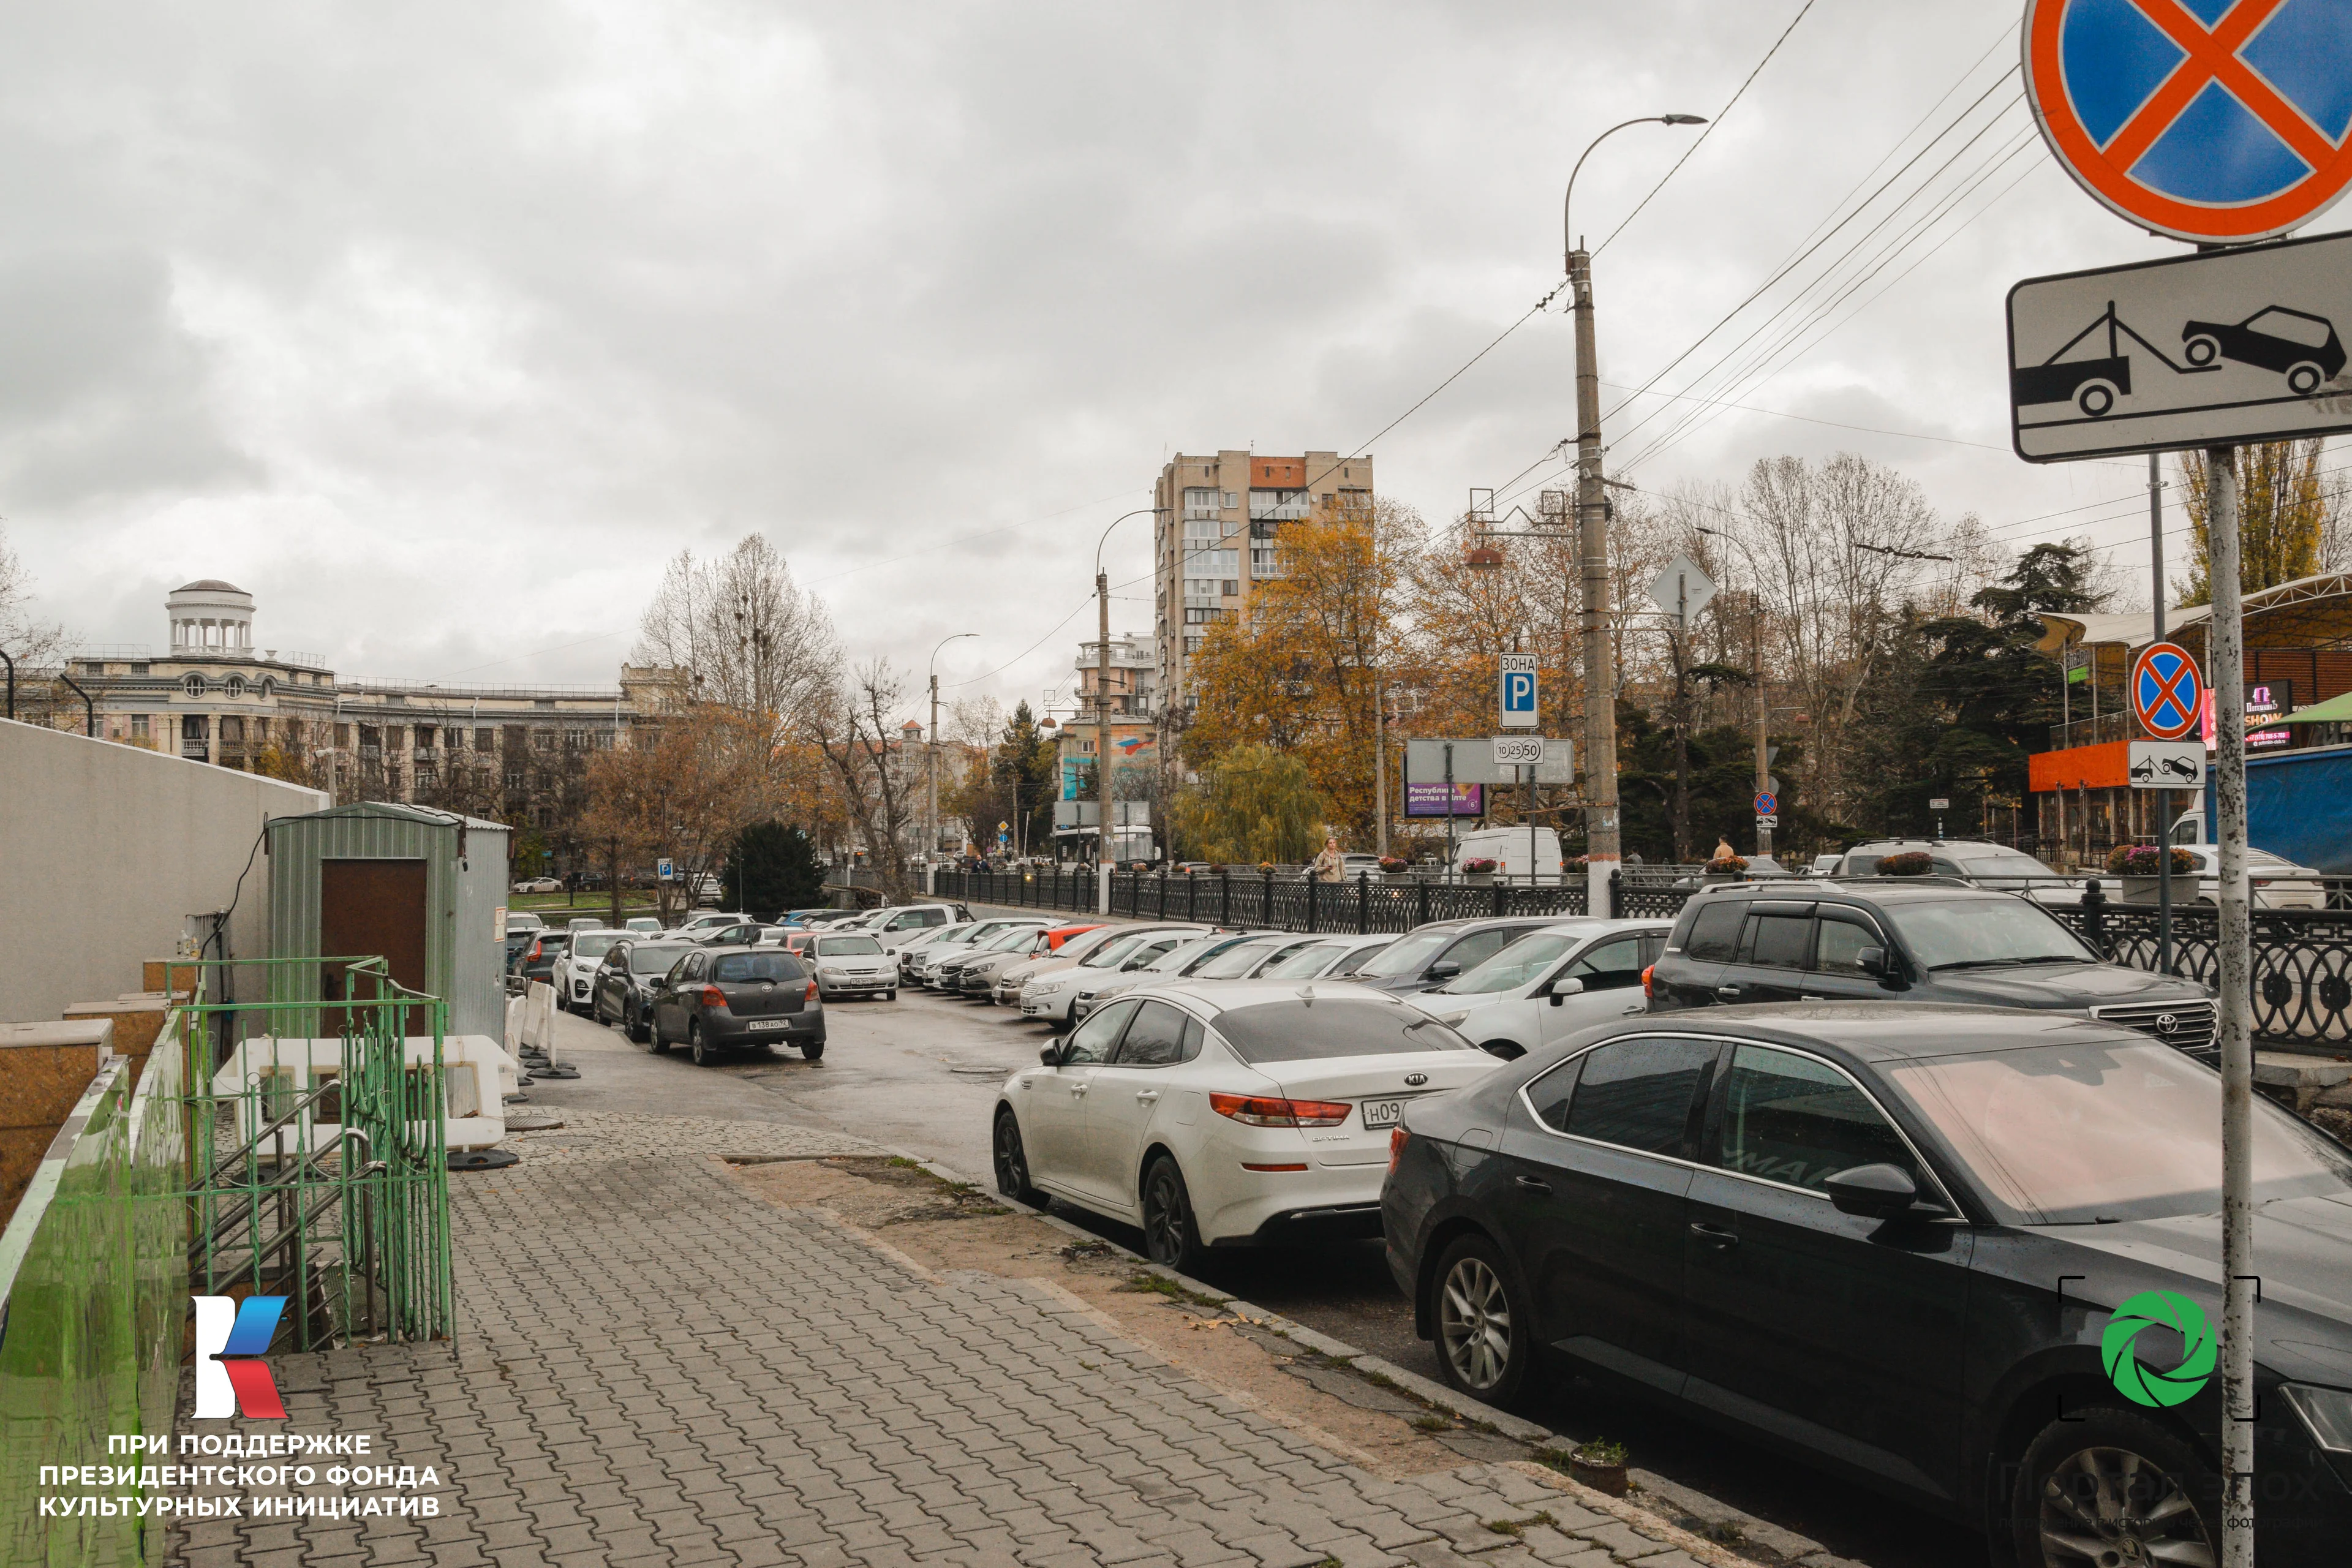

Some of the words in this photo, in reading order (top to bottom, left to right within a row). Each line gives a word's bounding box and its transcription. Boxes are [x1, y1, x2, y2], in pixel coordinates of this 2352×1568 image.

[1503, 658, 1535, 671] ЗОНА
[1513, 676, 1530, 709] P
[2245, 712, 2282, 726] SHOW
[1524, 745, 1537, 756] 50
[1408, 1075, 1425, 1084] KIA
